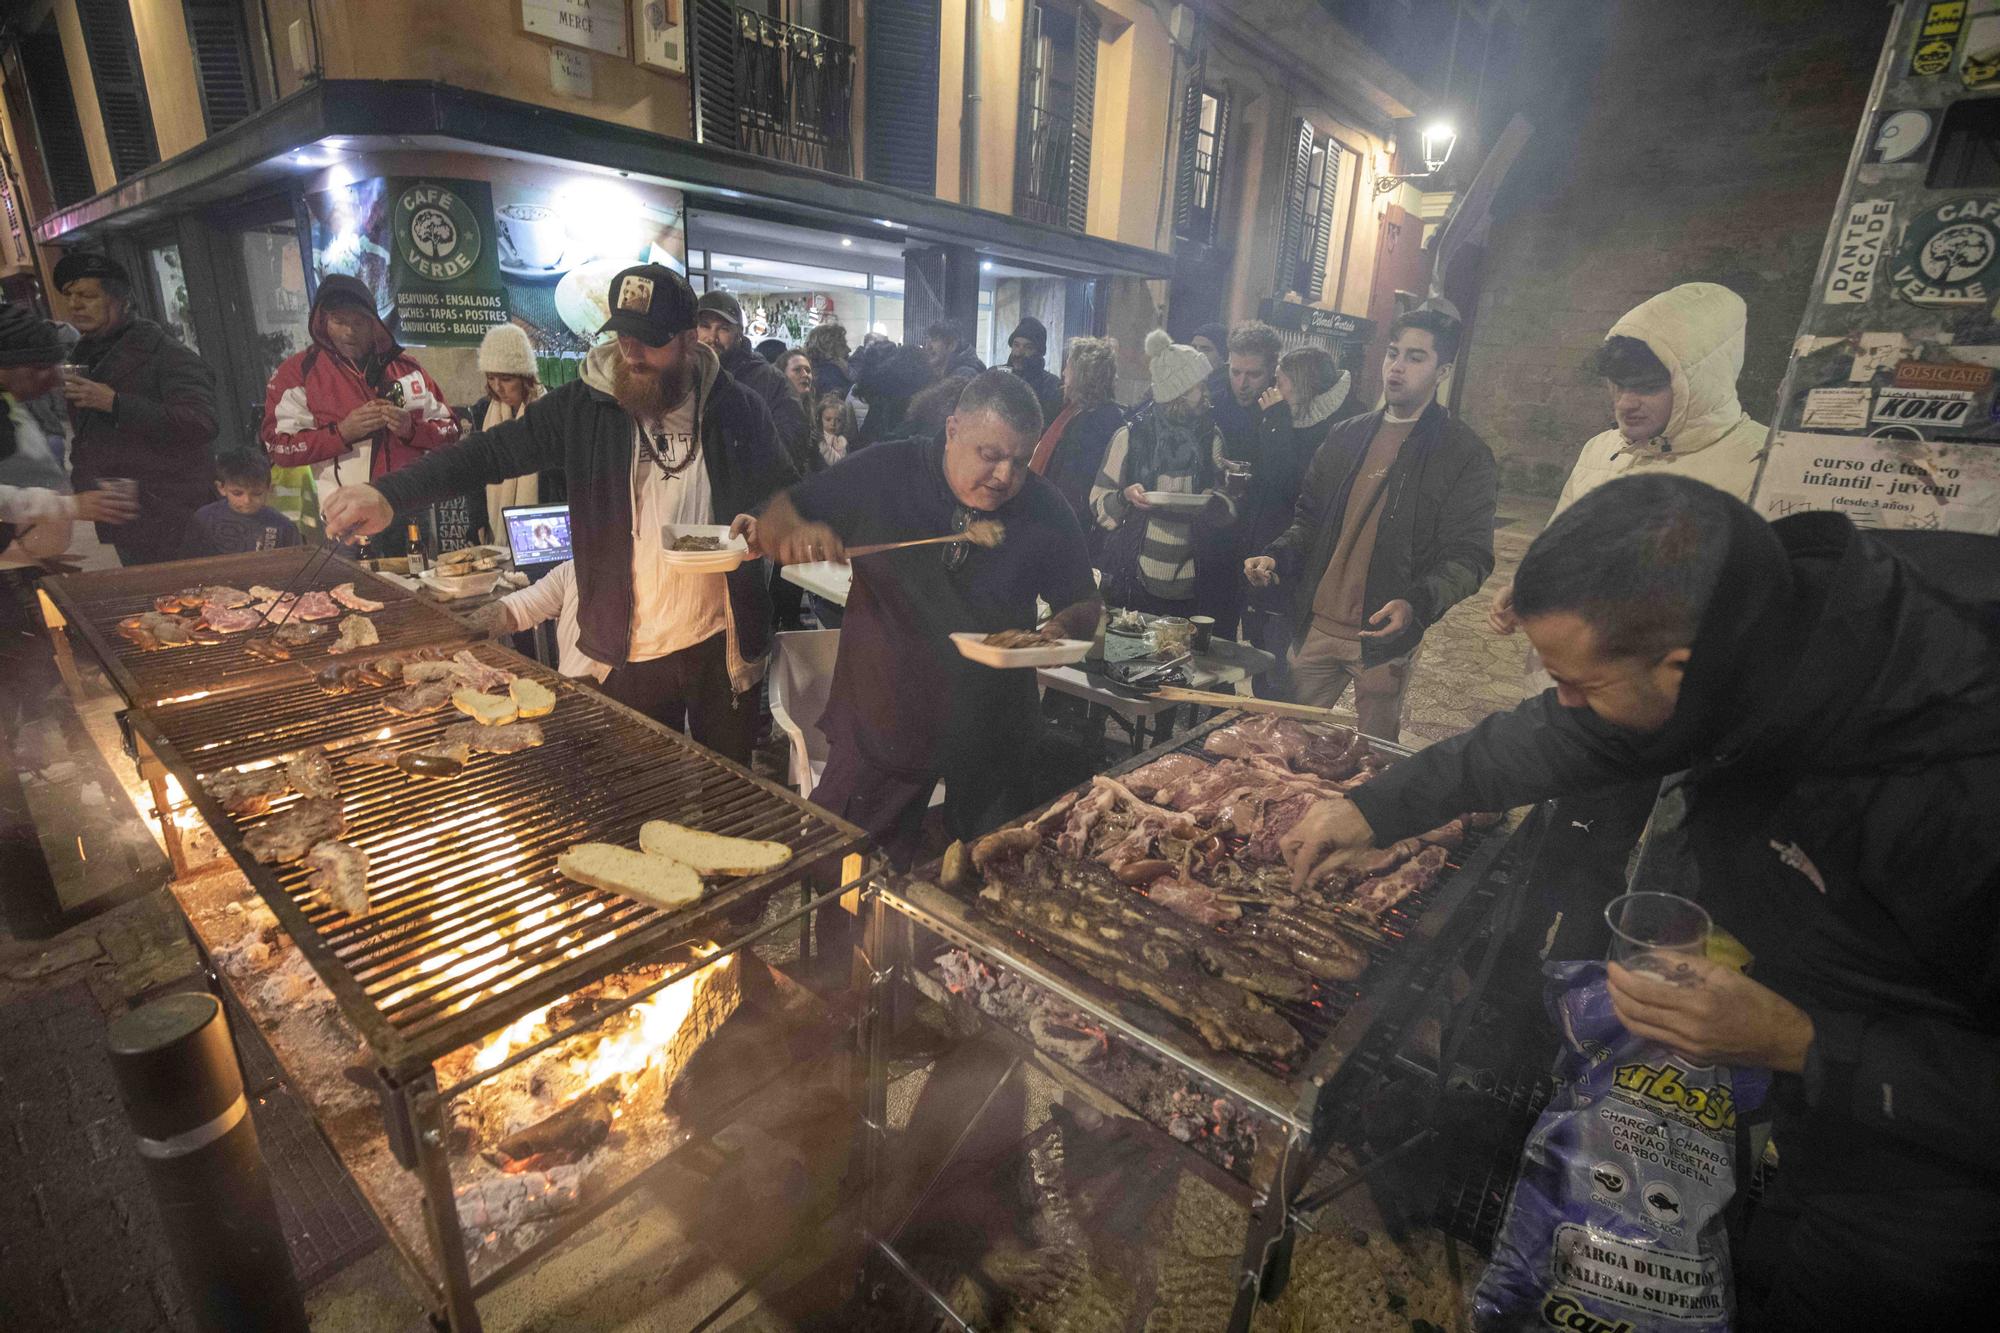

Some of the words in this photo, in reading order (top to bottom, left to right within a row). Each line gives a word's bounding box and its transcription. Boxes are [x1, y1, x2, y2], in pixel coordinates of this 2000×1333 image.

[404, 190, 452, 210] CAFÉ
[1832, 214, 1868, 291] DANTE
[1848, 204, 1890, 299] ARCADE
[408, 250, 471, 277] VERDE
[398, 293, 439, 305] DESAYUNOS
[446, 295, 501, 307] ENSALADAS
[430, 308, 457, 320] TAPAS
[465, 310, 507, 321] POSTRES
[400, 321, 446, 333] SANDWICHES
[453, 323, 500, 334] BAGUET
[1877, 399, 1969, 421] KOKO
[1814, 456, 1864, 471] curso
[1870, 459, 1893, 474] de
[1900, 461, 1960, 479] teao
[1803, 471, 1871, 490] infantil
[1887, 478, 1961, 498] juvenil
[1831, 496, 1869, 508] (desde
[1873, 500, 1879, 508] 3
[1882, 500, 1915, 513] años)
[440, 510, 470, 524] BAG
[1601, 1108, 1669, 1140] CHARCOAL
[1676, 1137, 1730, 1166] CHARBO
[1662, 1156, 1713, 1187] VEGETAL
[1669, 1145, 1718, 1176] VEGETAL
[1591, 1194, 1622, 1211] CARNES
[1640, 1214, 1682, 1238] PESCADOS
[1561, 1262, 1639, 1297] CALIDAD
[1643, 1286, 1721, 1309] SUPERIOR
